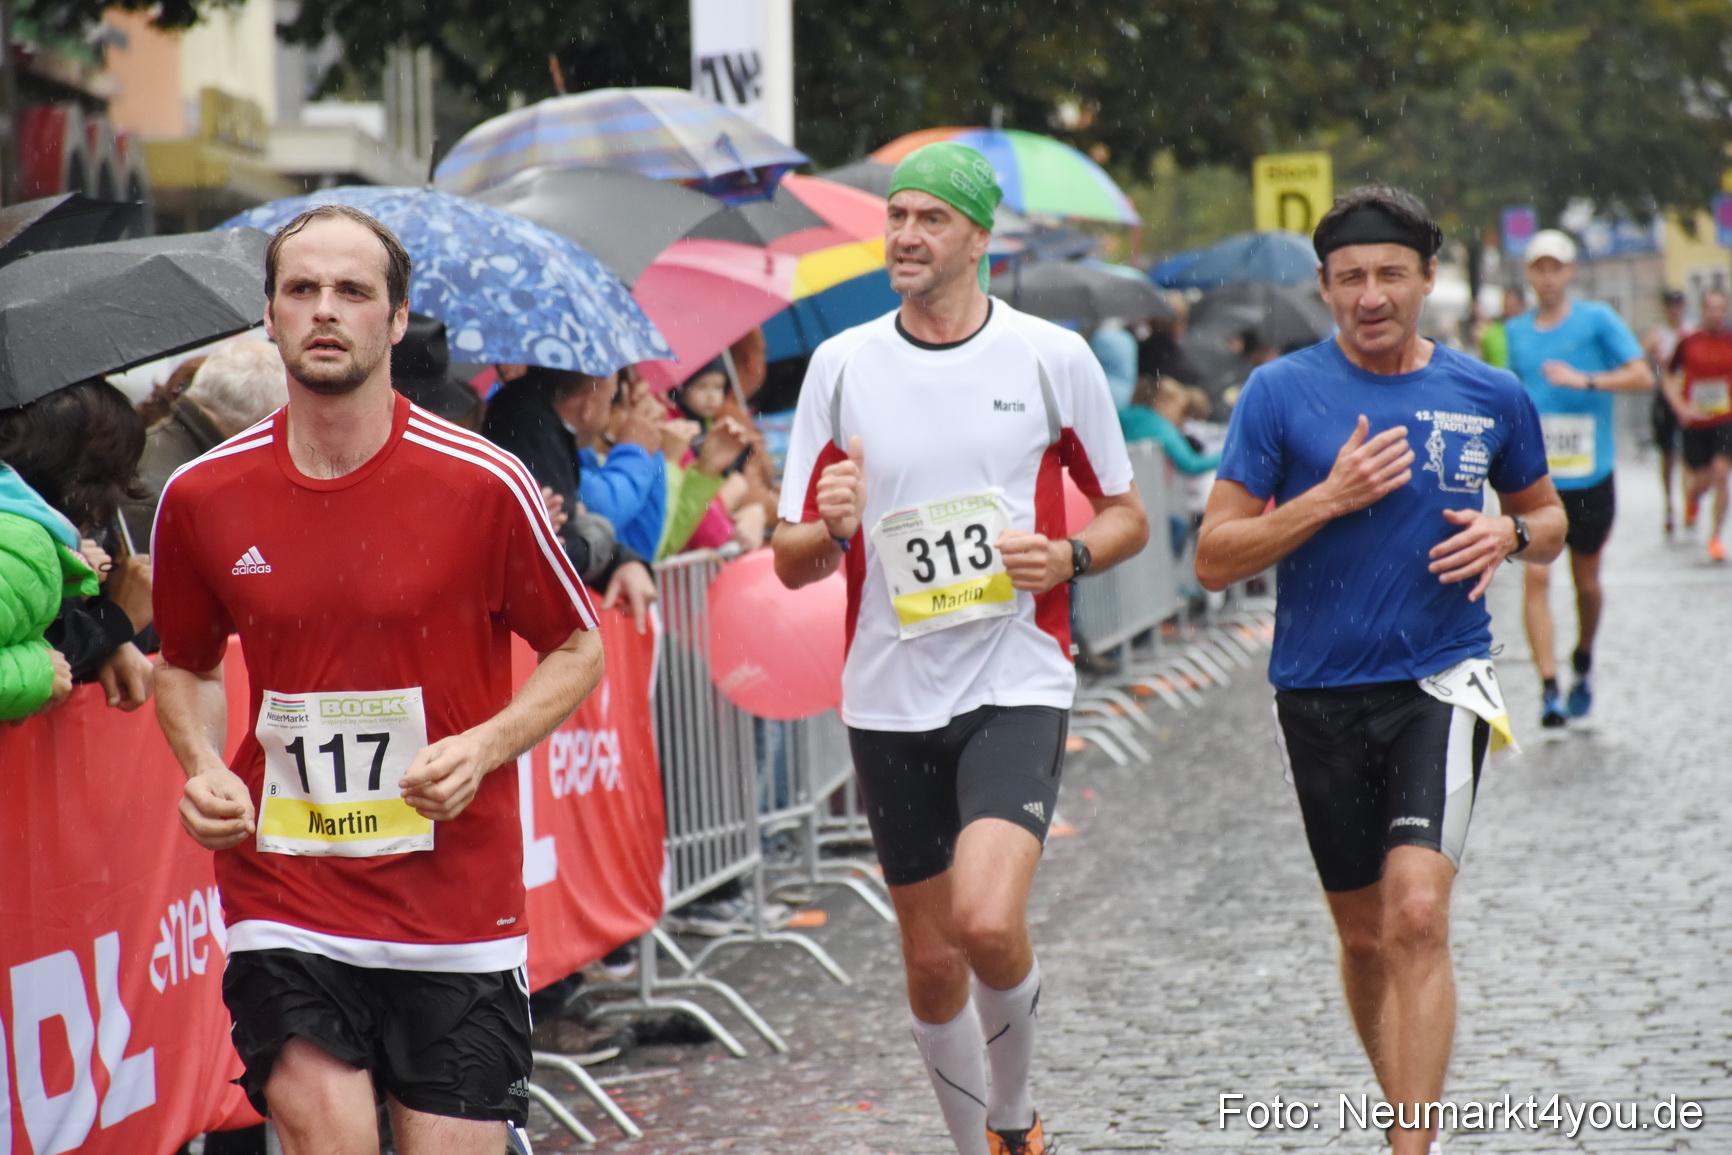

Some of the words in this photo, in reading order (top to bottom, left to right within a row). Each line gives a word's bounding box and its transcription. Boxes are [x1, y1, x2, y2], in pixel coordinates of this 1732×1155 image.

[993, 399, 1025, 411] Martin
[906, 523, 993, 584] 313
[231, 564, 272, 575] adidas
[931, 586, 984, 613] Martin
[266, 711, 310, 724] NeuerMarkt
[320, 697, 408, 718] BOCK
[285, 732, 390, 795] 117
[308, 810, 378, 836] Martin
